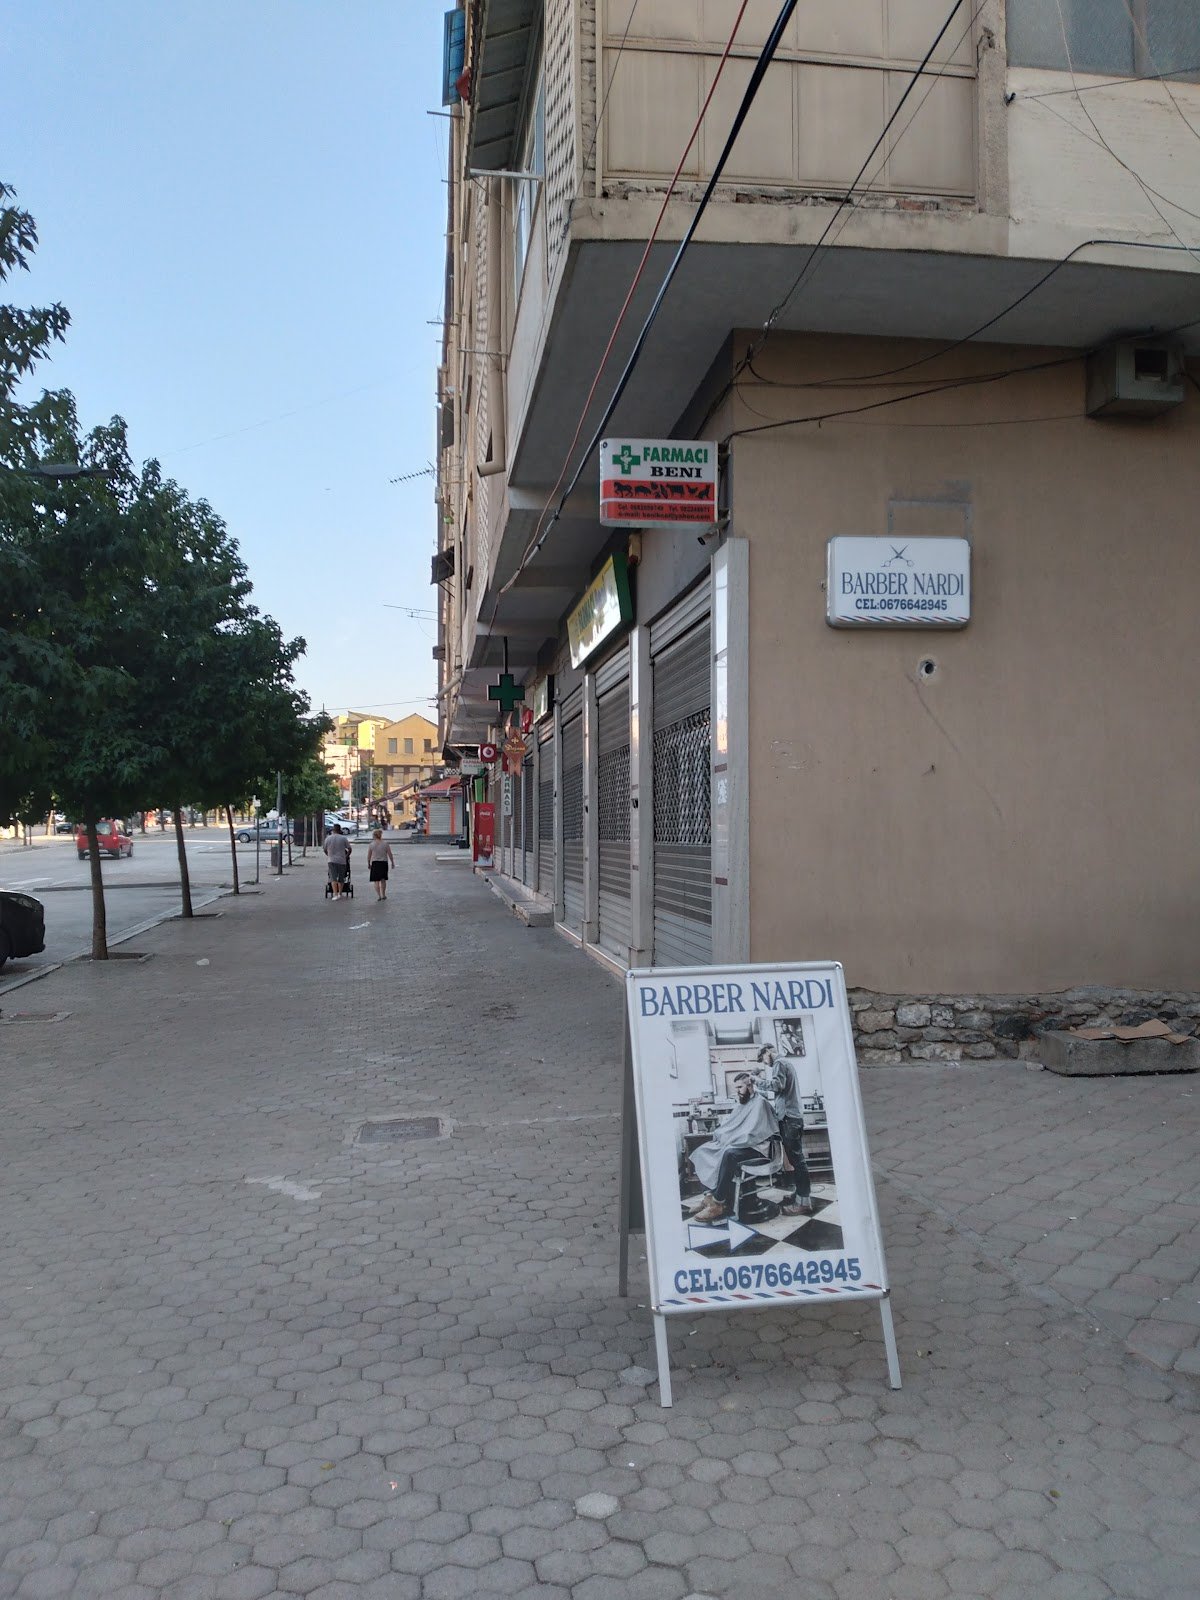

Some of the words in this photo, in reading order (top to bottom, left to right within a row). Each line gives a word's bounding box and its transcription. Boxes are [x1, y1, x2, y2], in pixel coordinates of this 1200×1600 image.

[643, 446, 709, 463] FARMACI
[650, 466, 703, 479] BENI
[841, 572, 908, 595] BARBER
[913, 572, 964, 596] NARDI
[855, 598, 948, 611] CEL:0676642945
[639, 983, 746, 1017] BARBER
[750, 979, 835, 1012] NARDI
[673, 1258, 862, 1294] CEL:0676642945
